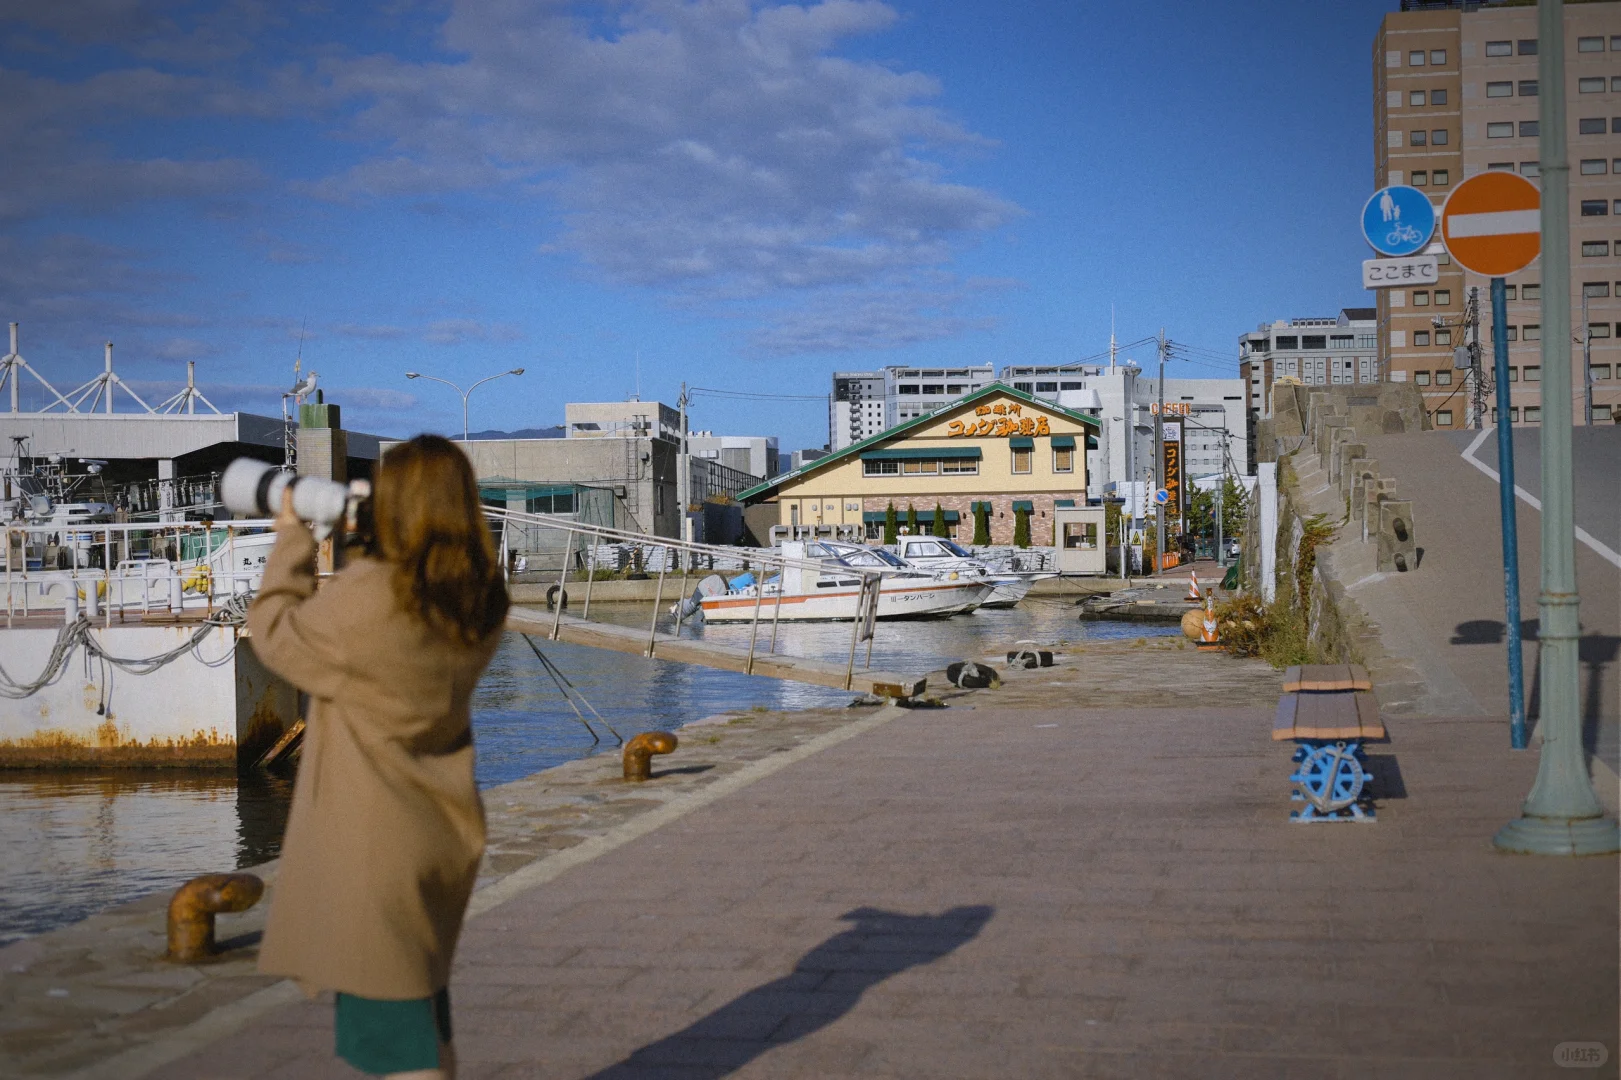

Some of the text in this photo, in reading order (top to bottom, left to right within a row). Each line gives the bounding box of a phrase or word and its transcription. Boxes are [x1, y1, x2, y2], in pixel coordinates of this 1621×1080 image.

[1369, 263, 1433, 281] ここまで
[1151, 402, 1191, 415] CFFEE
